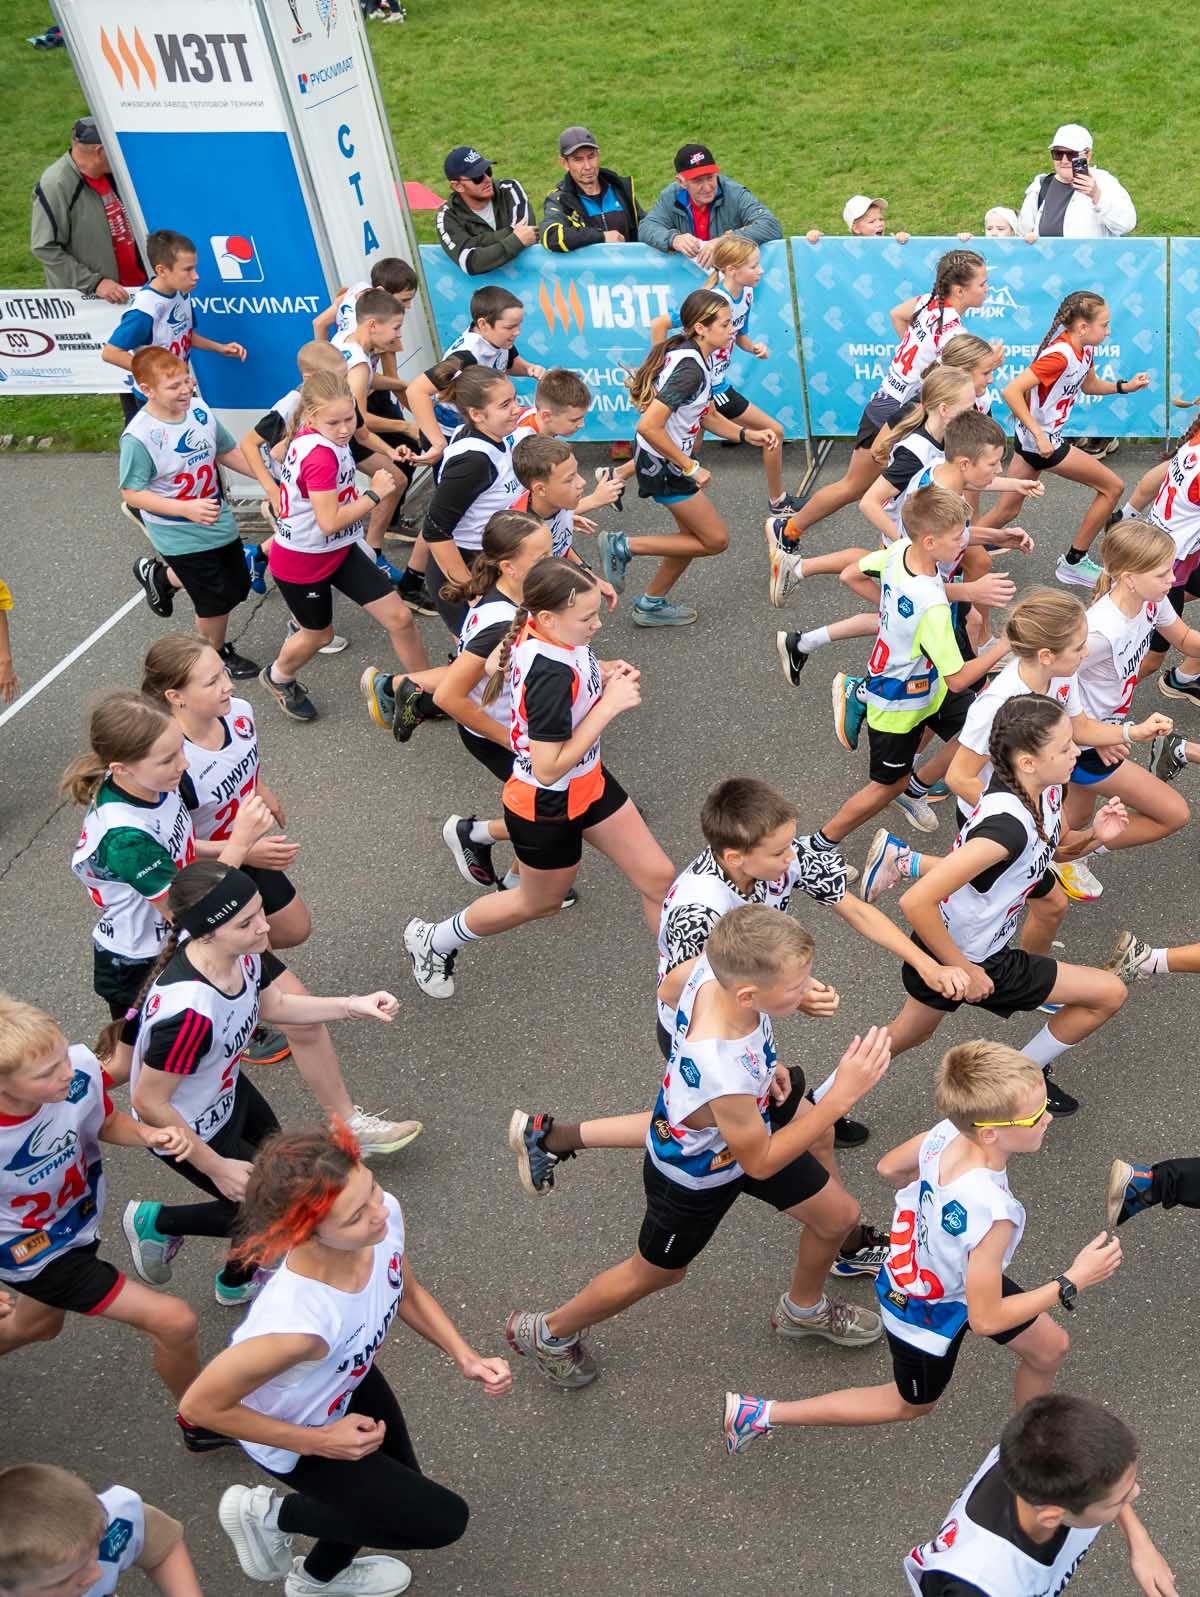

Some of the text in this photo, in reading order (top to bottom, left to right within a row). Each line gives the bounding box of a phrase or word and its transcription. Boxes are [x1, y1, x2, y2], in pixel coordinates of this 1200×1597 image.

[154, 33, 253, 83] ИЗТТ
[310, 56, 353, 86] РУСКЛИМАТ
[587, 283, 671, 329] ИЗТТ
[855, 364, 884, 380] НА
[174, 464, 218, 501] 22
[211, 742, 259, 806] УДМУРТИ
[28, 1145, 77, 1186] СТРИЖ
[10, 1153, 89, 1230] 24
